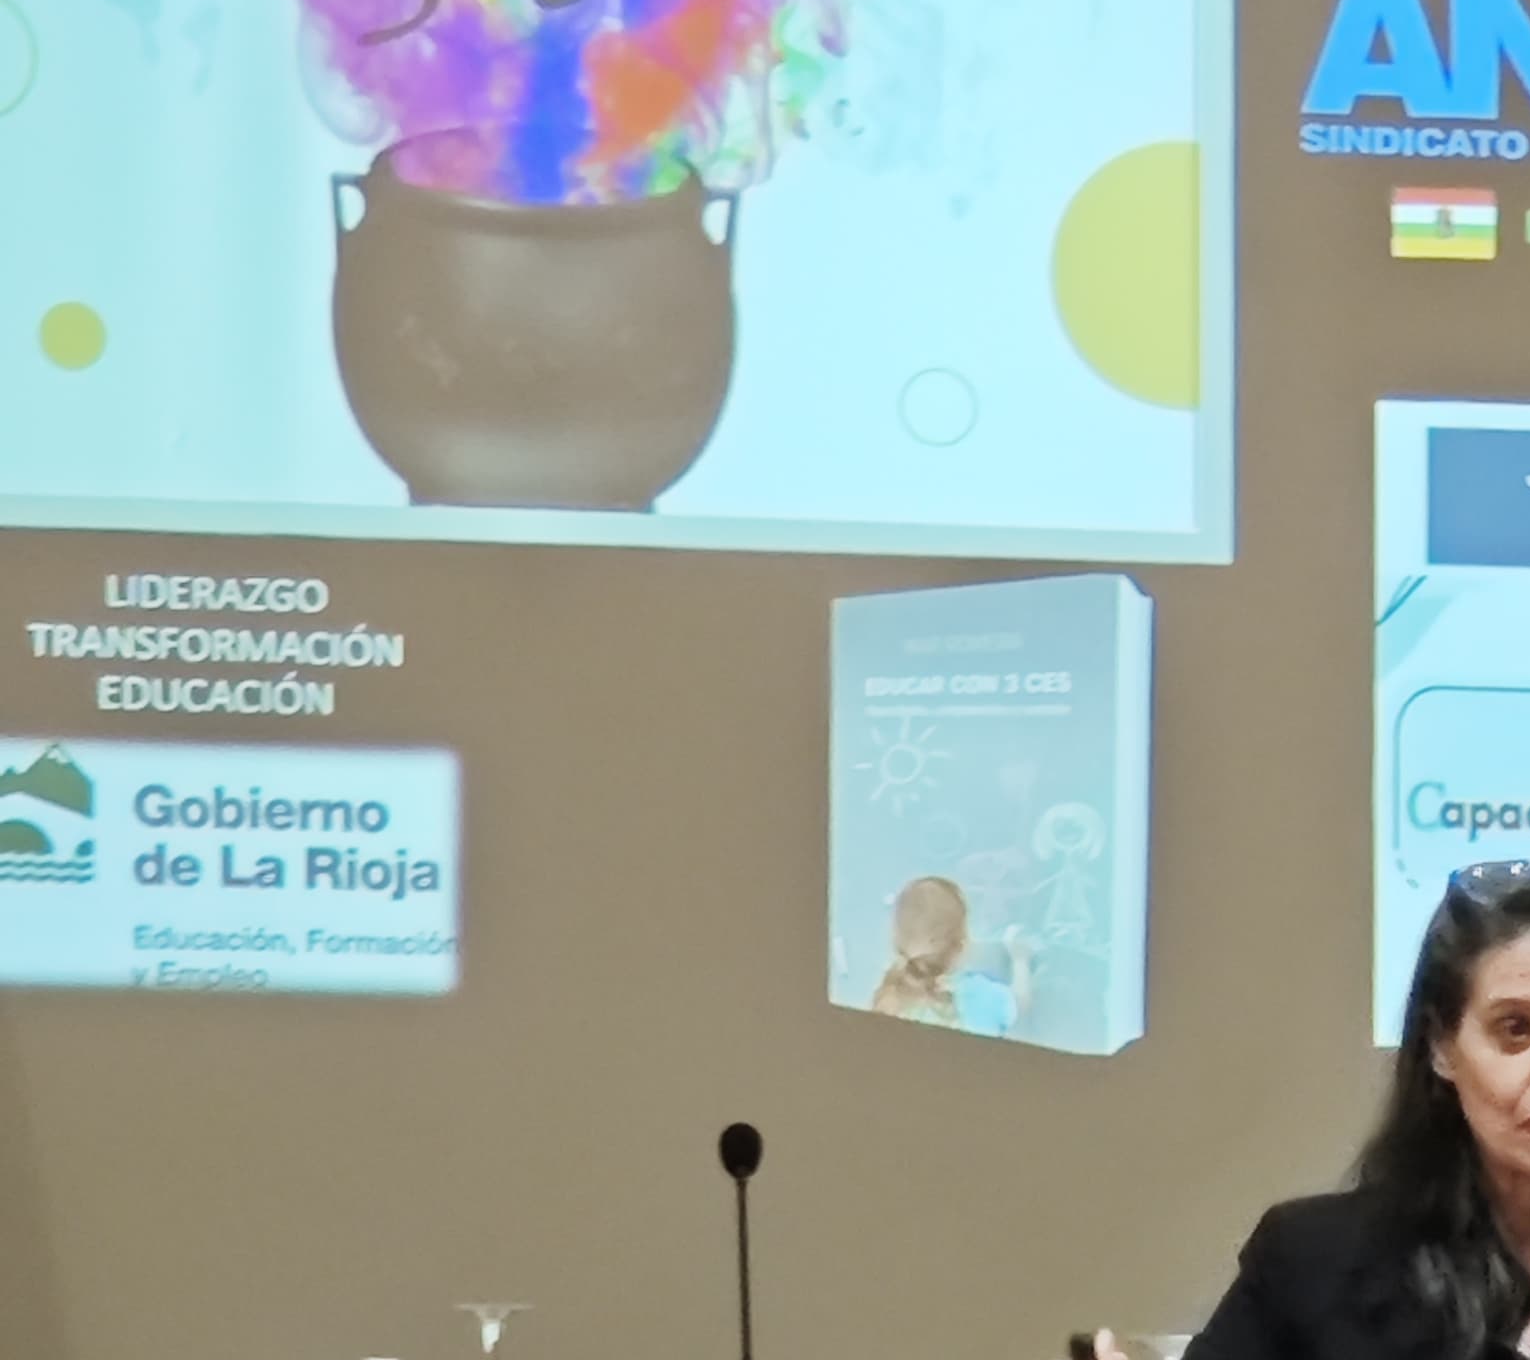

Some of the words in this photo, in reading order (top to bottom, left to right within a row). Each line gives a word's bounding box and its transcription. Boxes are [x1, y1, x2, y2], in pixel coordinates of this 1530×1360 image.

[1300, 122, 1529, 160] SINDICATO
[105, 573, 329, 614] LIDERAZGO
[25, 621, 404, 668] TRANSFORMACIÓN
[97, 671, 335, 715] EDUCACIÓN
[133, 783, 390, 834] Gobierno
[133, 843, 203, 887] de
[219, 845, 285, 889] La
[305, 847, 440, 900] Rioja
